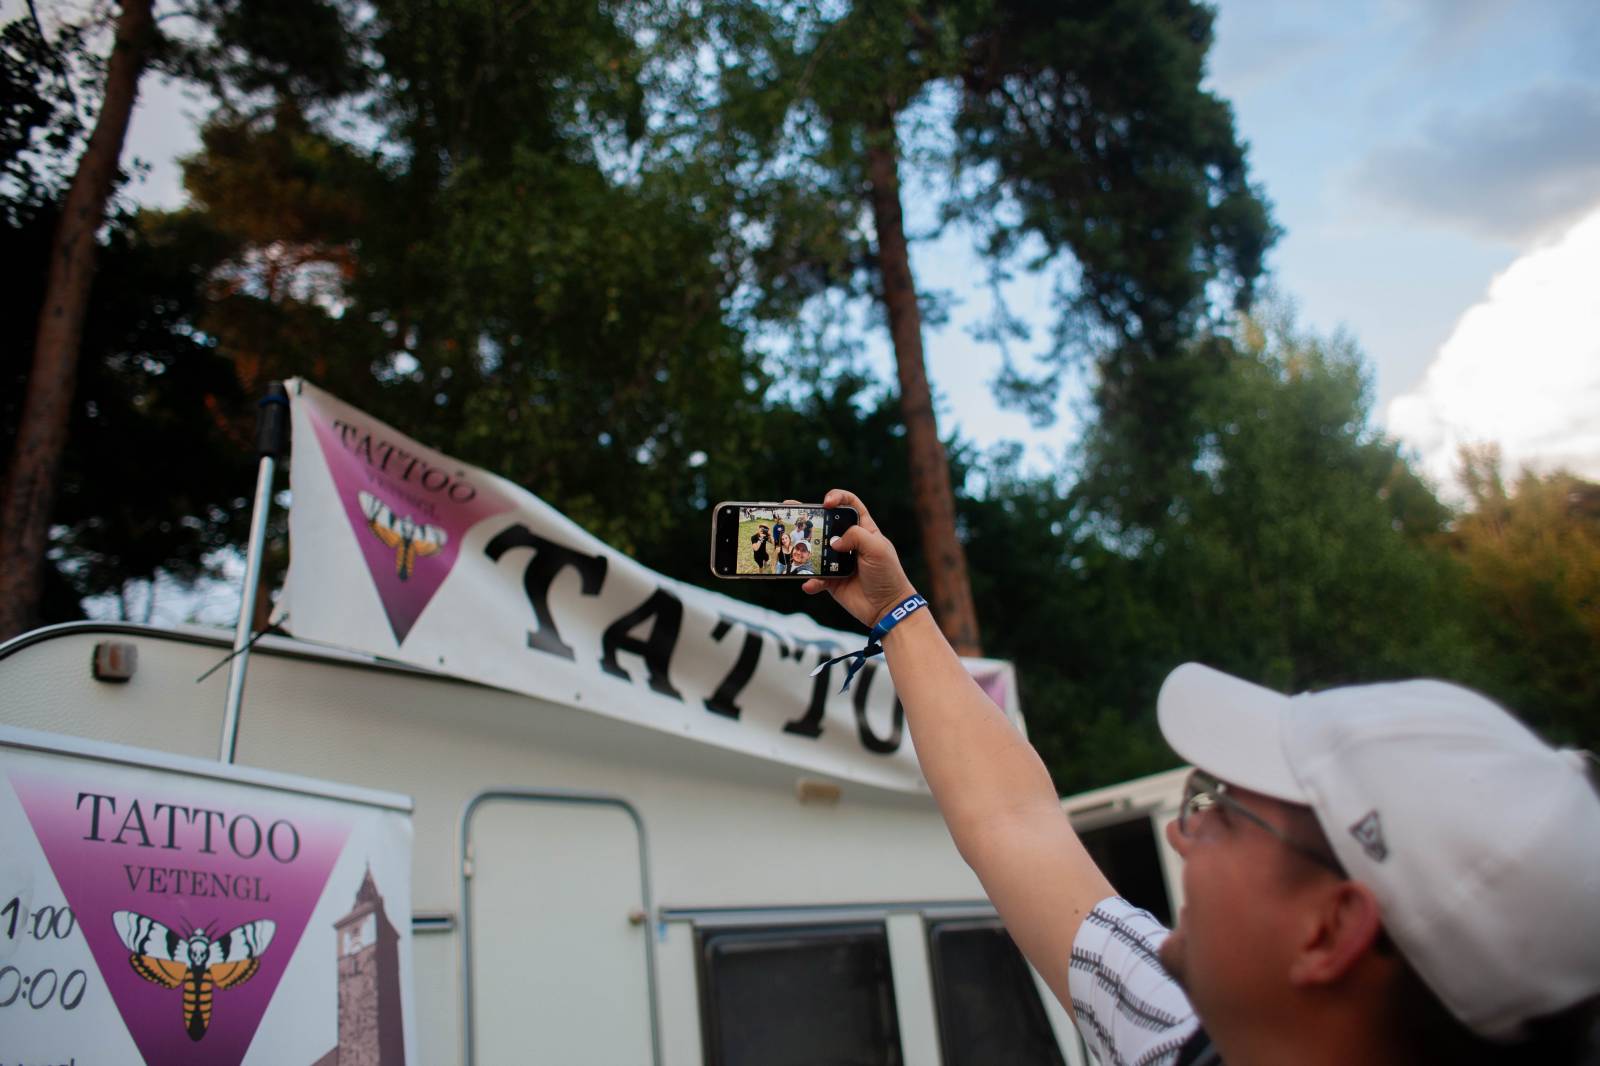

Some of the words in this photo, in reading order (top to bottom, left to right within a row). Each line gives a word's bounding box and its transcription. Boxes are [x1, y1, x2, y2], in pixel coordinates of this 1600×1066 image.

[333, 420, 476, 505] TATTOO
[76, 791, 300, 865] TATTOO
[122, 864, 271, 903] VETENGL
